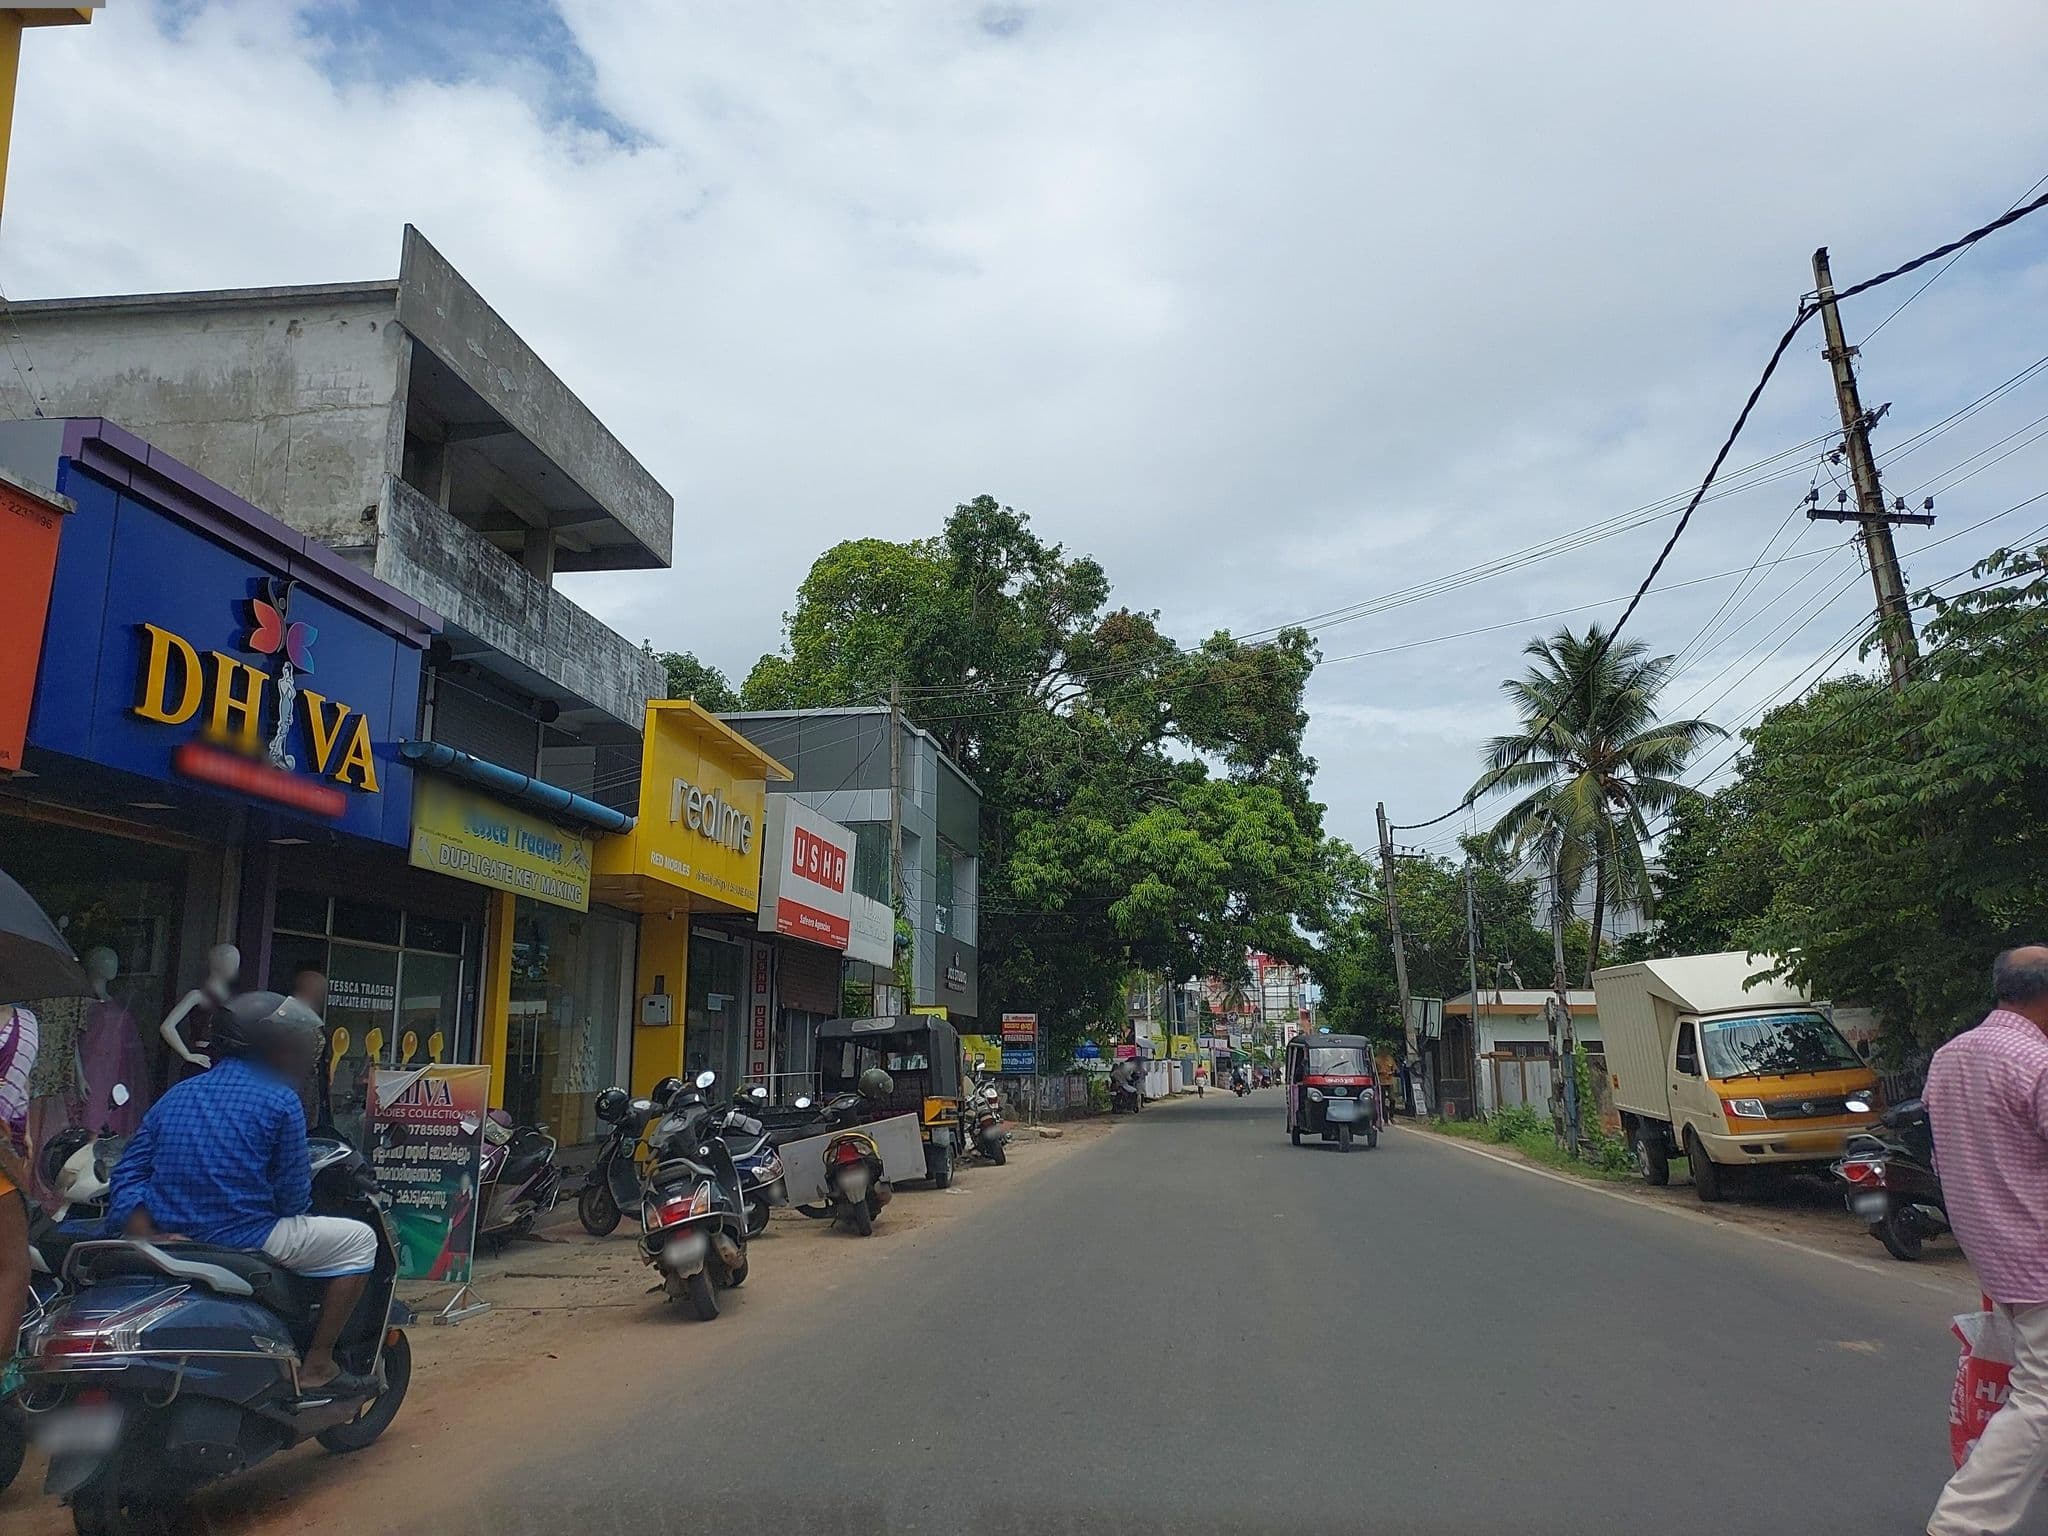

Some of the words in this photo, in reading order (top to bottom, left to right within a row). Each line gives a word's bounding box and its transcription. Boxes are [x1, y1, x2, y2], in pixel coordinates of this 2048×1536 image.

[669, 776, 753, 855] realme
[515, 823, 564, 866] Traders
[796, 835, 844, 884] USHA
[439, 843, 513, 884] DUPLICATE
[515, 865, 540, 892] KEY
[540, 874, 583, 905] MAKING
[328, 995, 359, 1008] DUPLICATE
[360, 997, 371, 1009] KEY
[371, 998, 393, 1010] MAKING
[329, 980, 359, 993] TESSCA
[361, 983, 394, 997] TRADERS
[755, 1006, 765, 1050] USHA
[406, 1124, 459, 1137] 07856989
